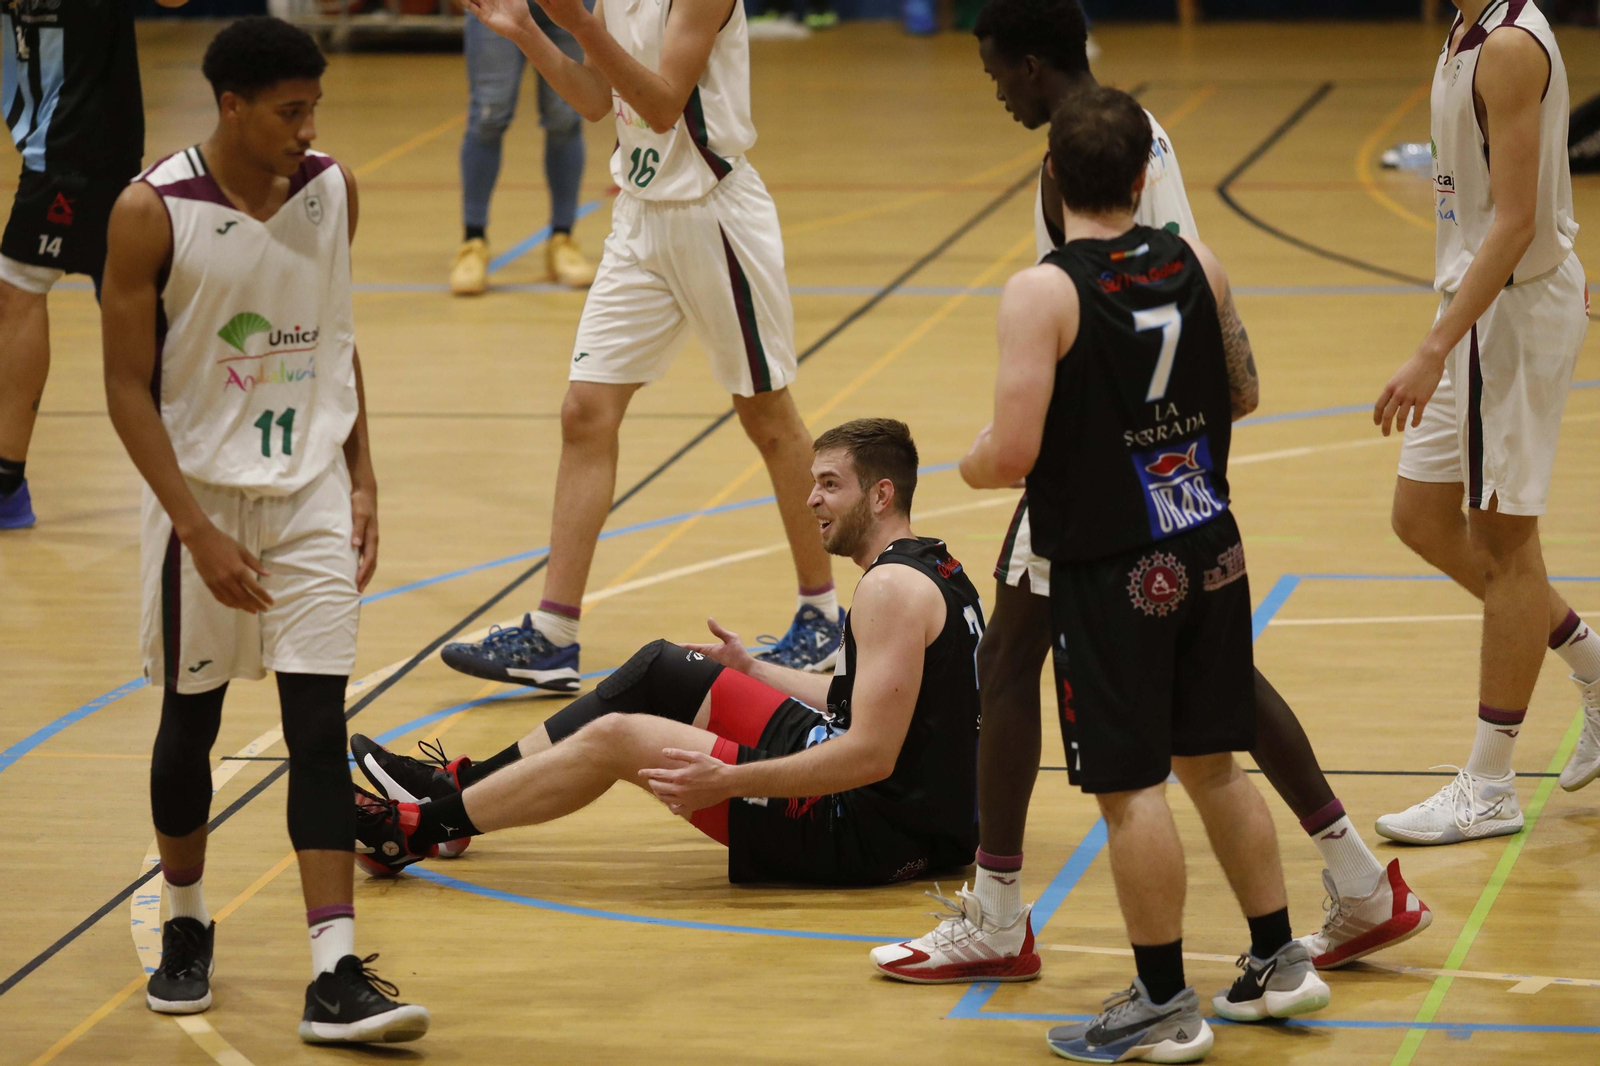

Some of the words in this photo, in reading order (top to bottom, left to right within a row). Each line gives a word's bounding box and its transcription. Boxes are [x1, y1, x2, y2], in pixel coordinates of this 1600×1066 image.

[627, 147, 660, 188] 16
[38, 234, 63, 258] 14
[268, 324, 320, 347] Unica
[1131, 302, 1182, 402] 7
[1154, 402, 1180, 421] LA
[253, 407, 297, 458] 11
